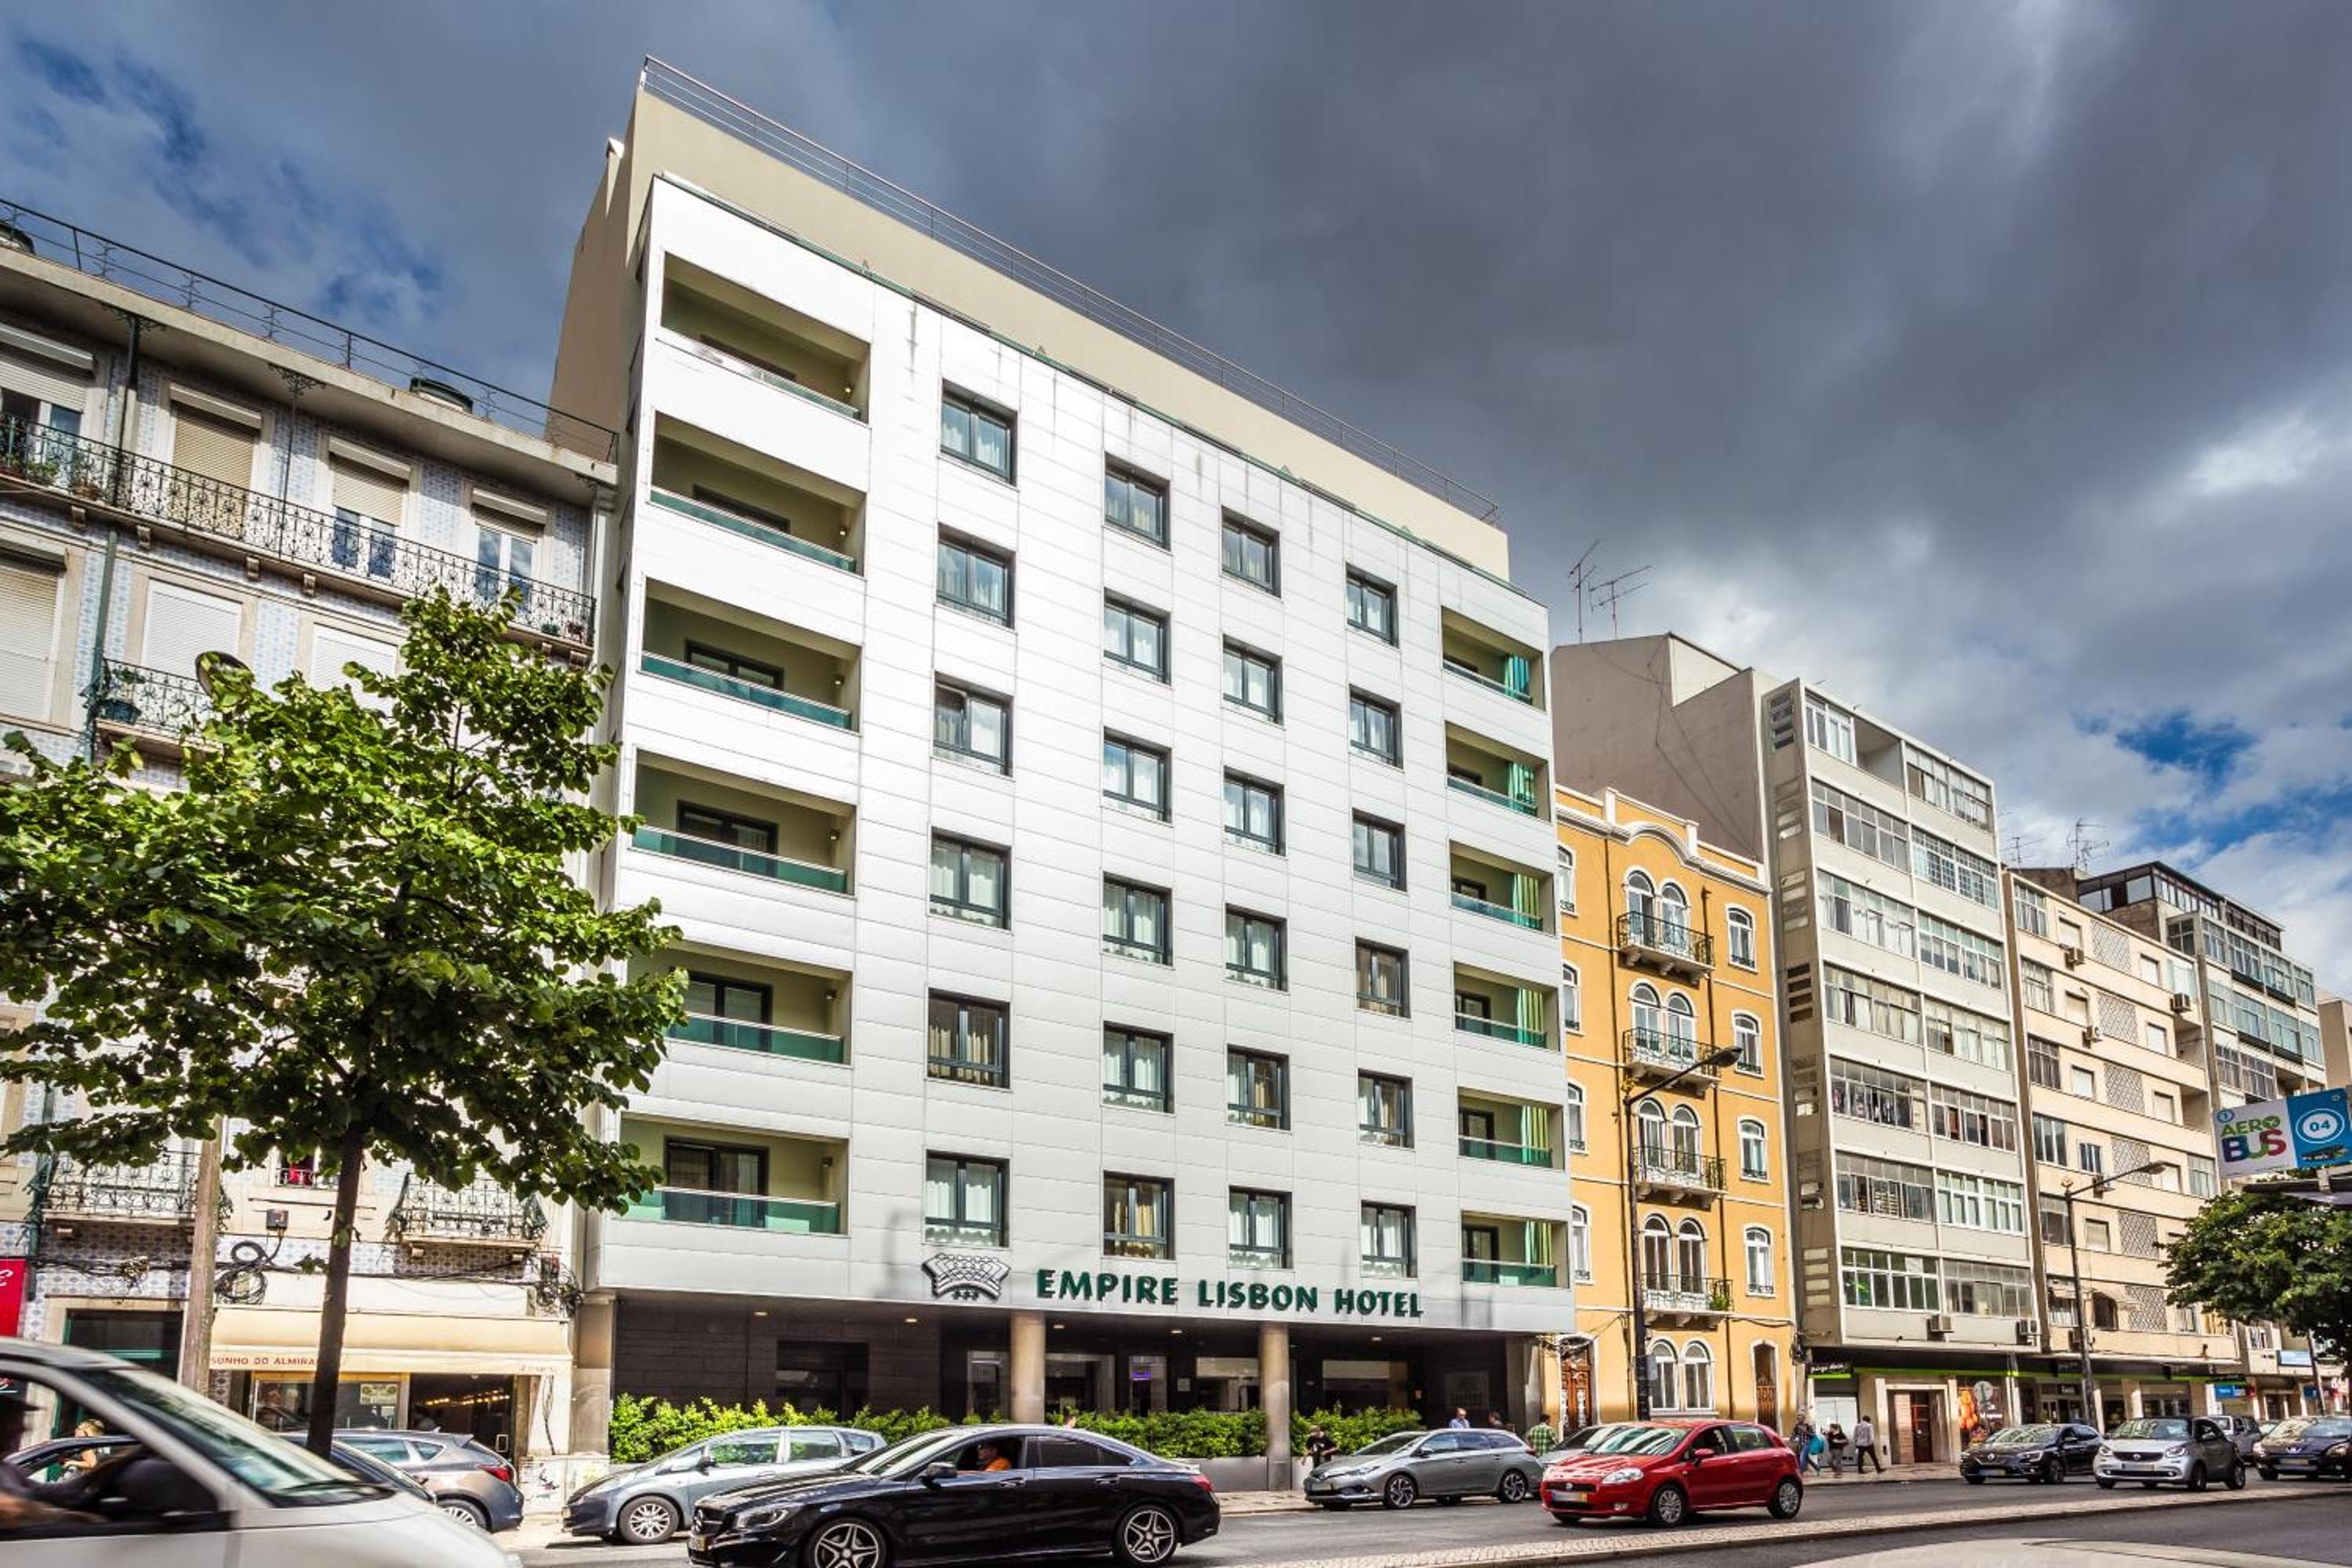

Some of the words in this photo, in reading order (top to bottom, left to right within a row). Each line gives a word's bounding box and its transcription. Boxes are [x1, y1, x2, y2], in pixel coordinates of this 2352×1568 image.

[2309, 1120, 2331, 1132] 04
[2221, 1128, 2287, 1163] BUS
[1036, 1268, 1179, 1305] EMPIRE
[1197, 1279, 1319, 1313] LISBON
[1334, 1288, 1424, 1318] HOTEL
[253, 1357, 269, 1366] DO
